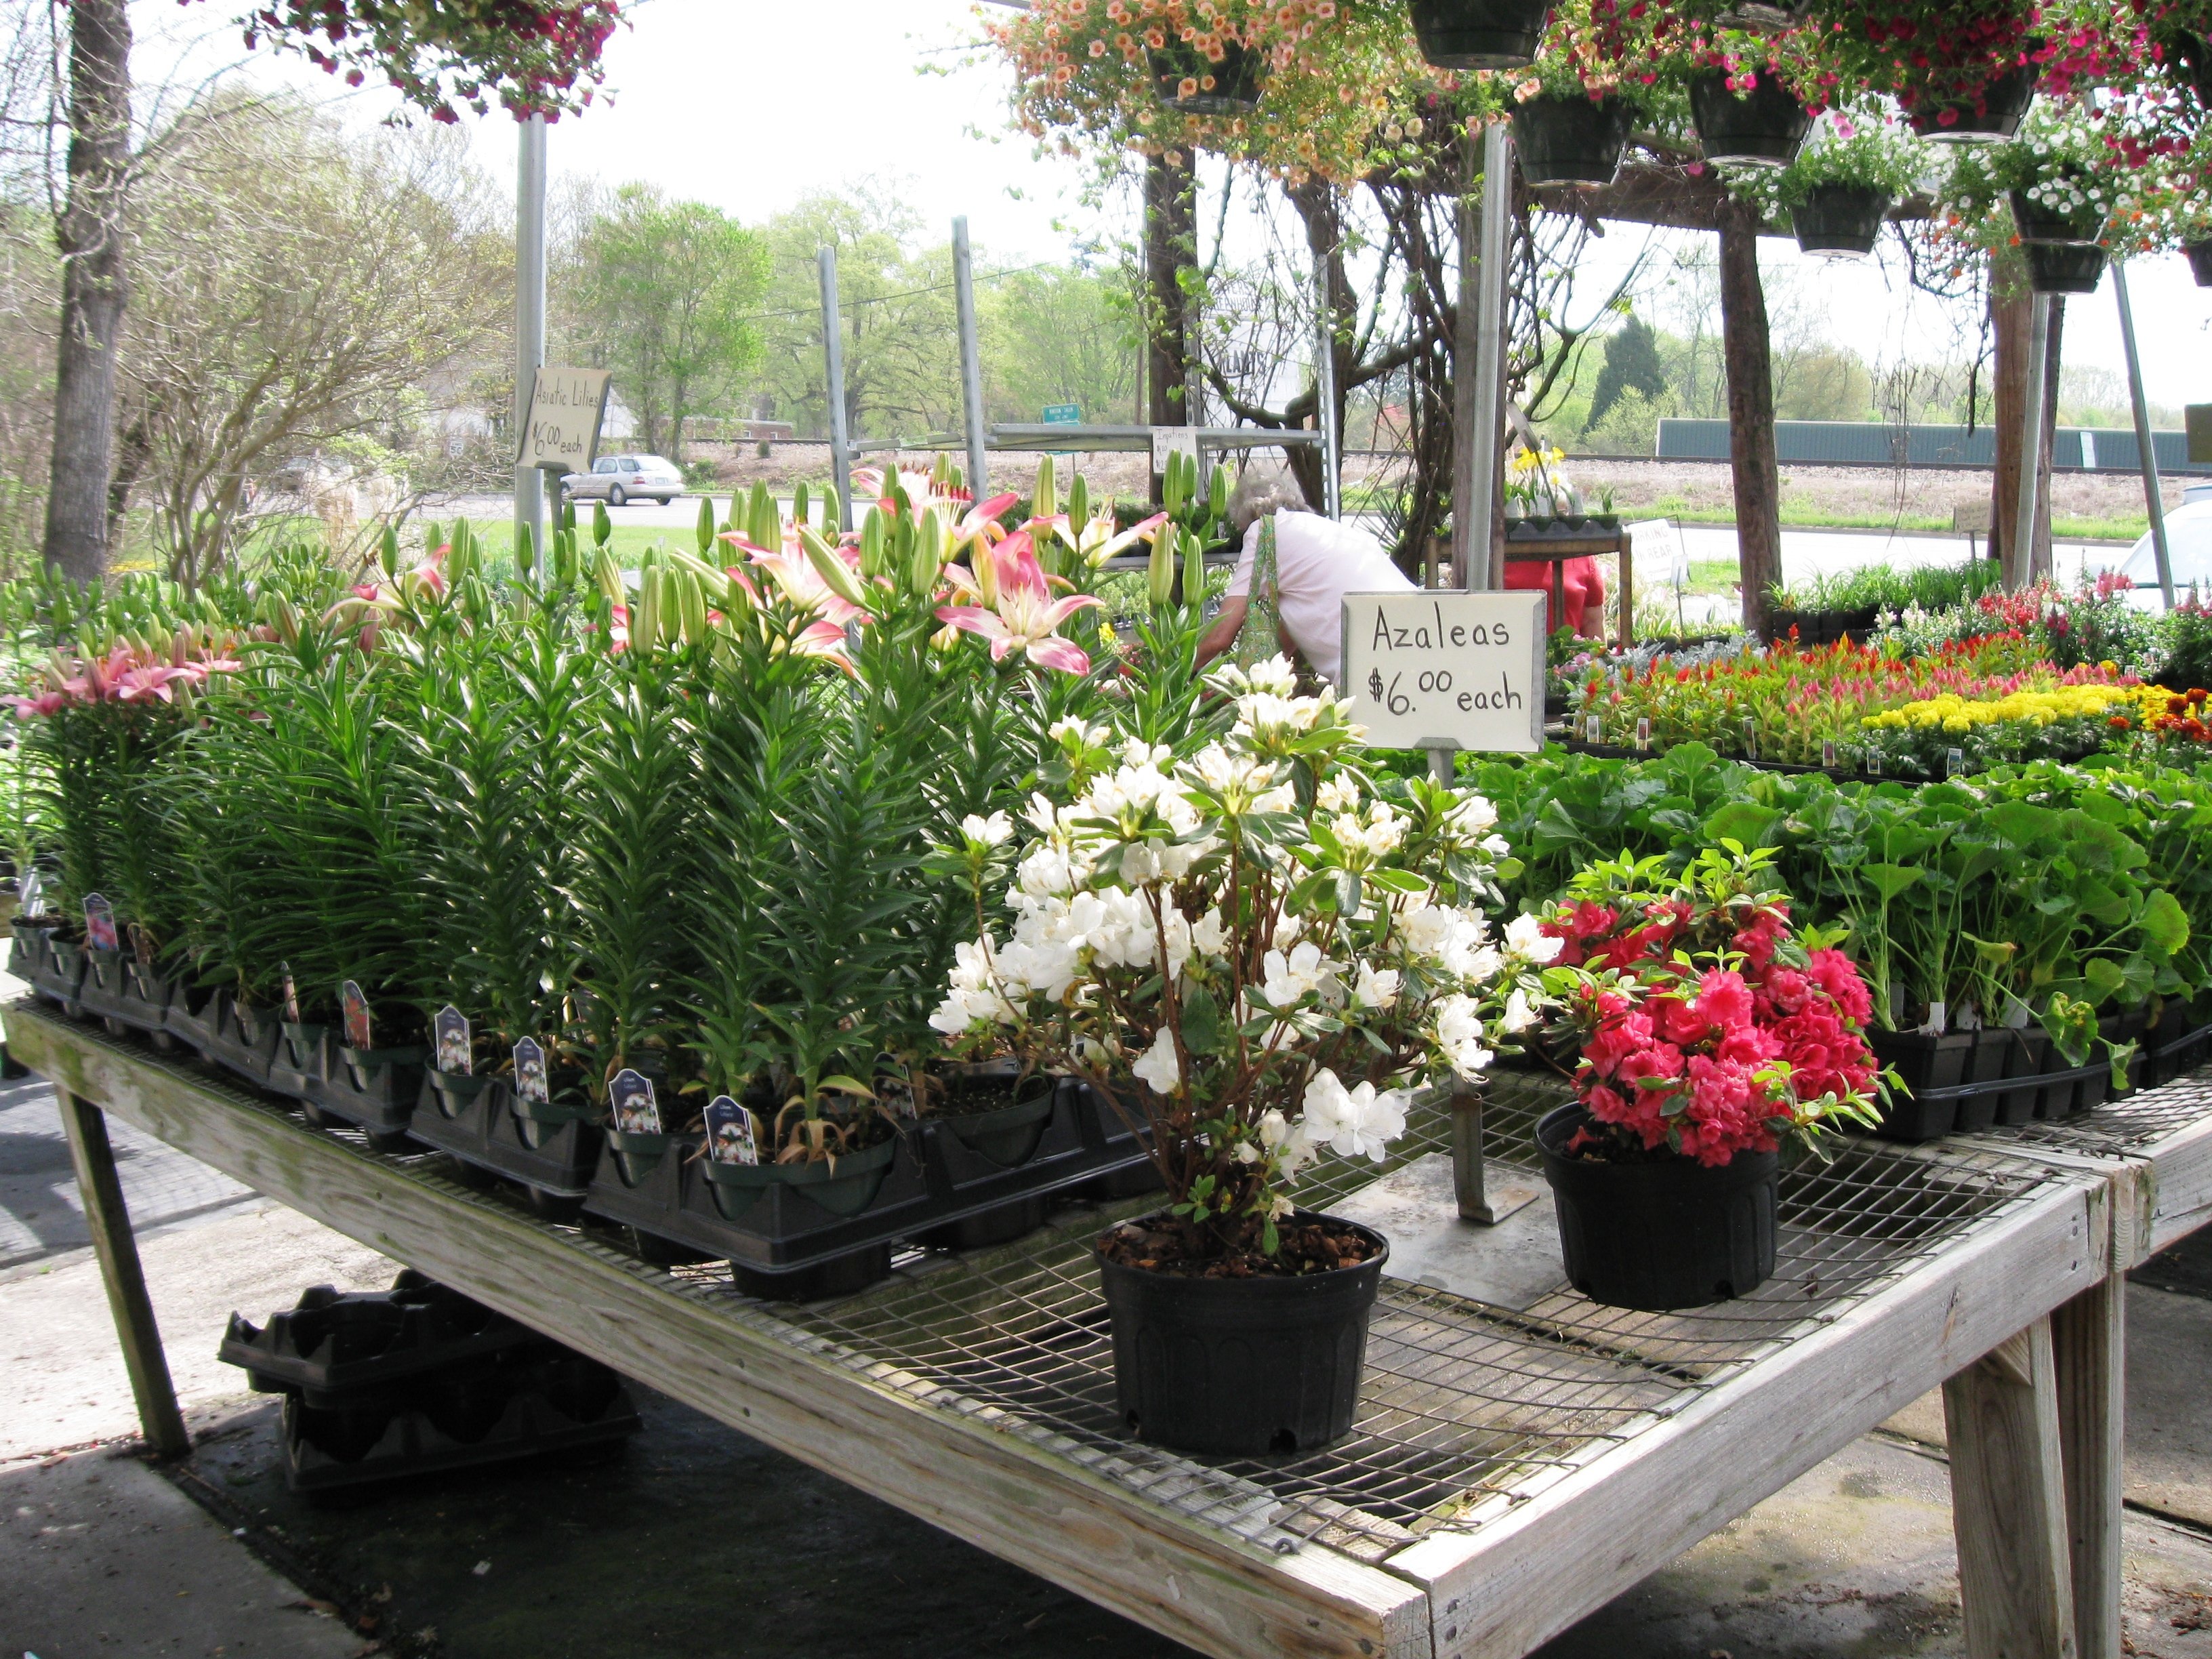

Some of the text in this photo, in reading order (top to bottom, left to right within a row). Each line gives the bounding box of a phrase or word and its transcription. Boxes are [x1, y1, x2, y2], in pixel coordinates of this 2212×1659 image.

[535, 376, 598, 407] Asiatic Lilies
[560, 434, 582, 453] each
[1631, 526, 1669, 543] ARKING
[1647, 544, 1673, 559] REAR
[1373, 600, 1510, 651] Azaleas
[1368, 667, 1522, 716] $6.00 each
